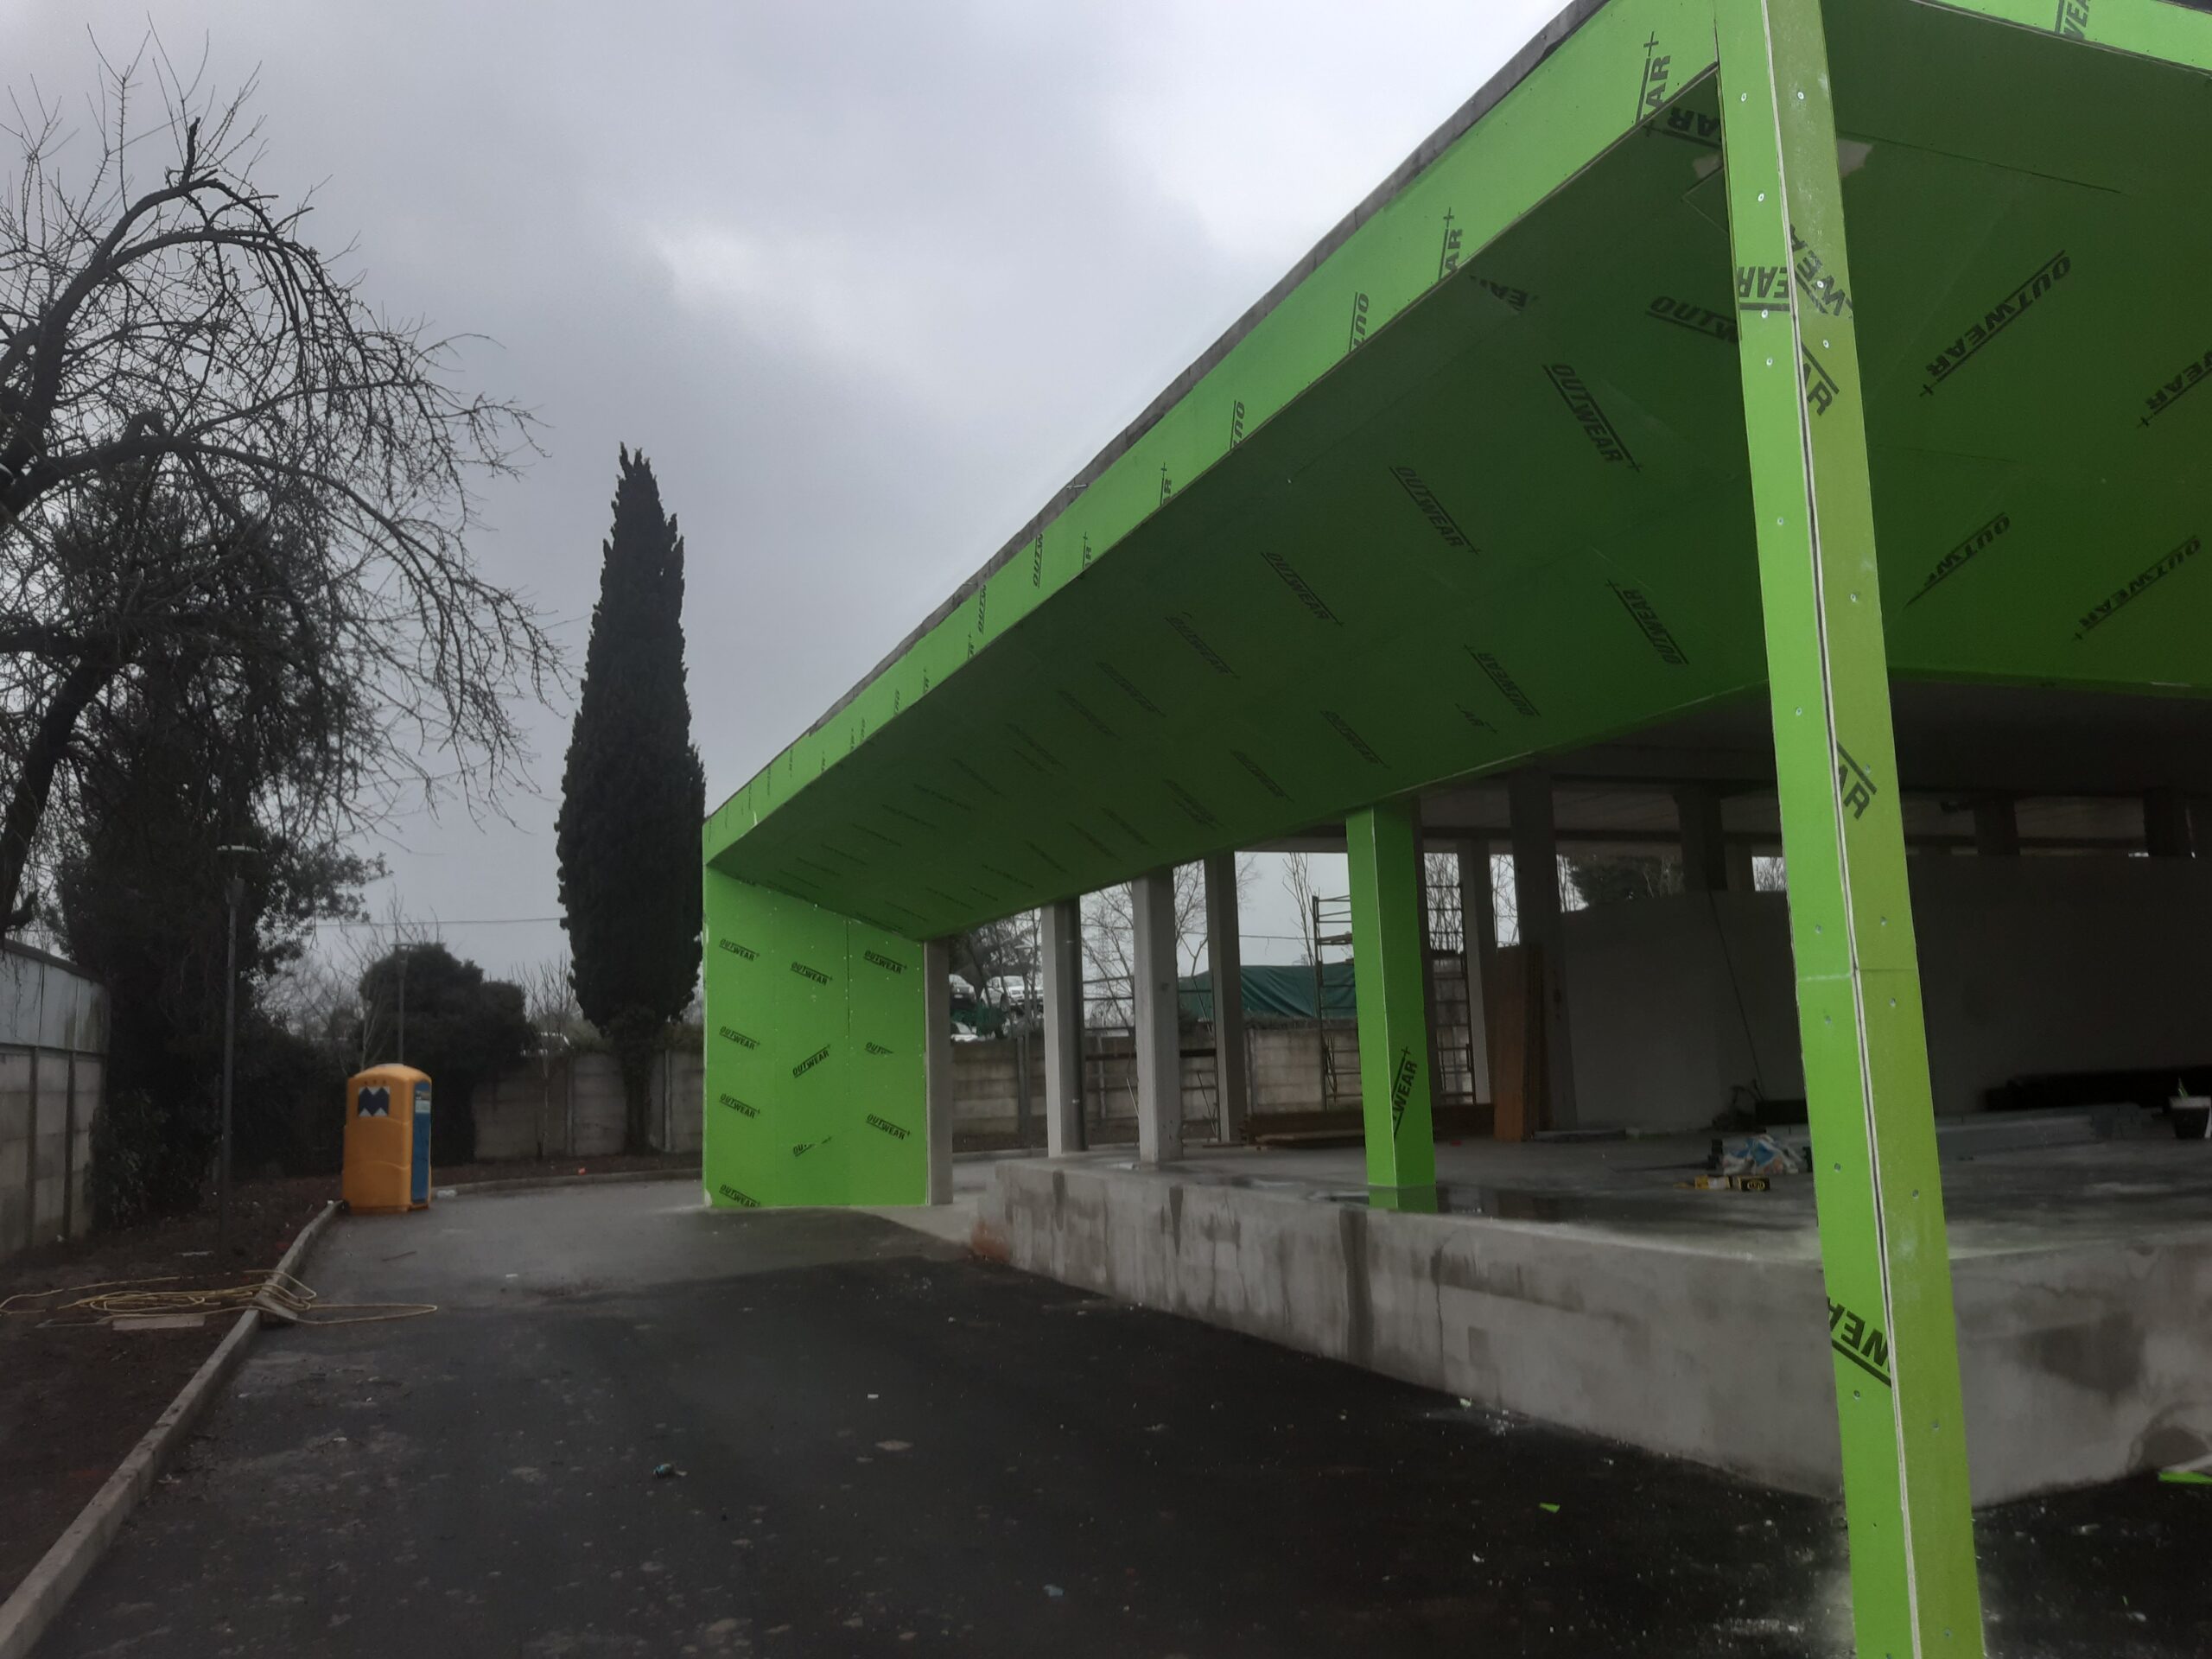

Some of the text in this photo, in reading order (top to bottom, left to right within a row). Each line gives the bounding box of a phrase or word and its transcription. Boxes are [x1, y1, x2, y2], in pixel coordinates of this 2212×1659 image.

[1925, 255, 2072, 380] OUTWEAR
[1548, 362, 1626, 461] OUTWEAR
[1393, 467, 1465, 547] OUTWEAR
[2078, 537, 2202, 627] OUTWEAR
[719, 938, 756, 962] OUTWEAR
[865, 950, 902, 975] OUTWEAR
[790, 961, 829, 986] OUTWEAR
[719, 1026, 756, 1051] OUTWEAR
[792, 1049, 830, 1077] OUTWEAR
[720, 1093, 756, 1119] OUTWEAR
[866, 1113, 906, 1141] OUTWEAR
